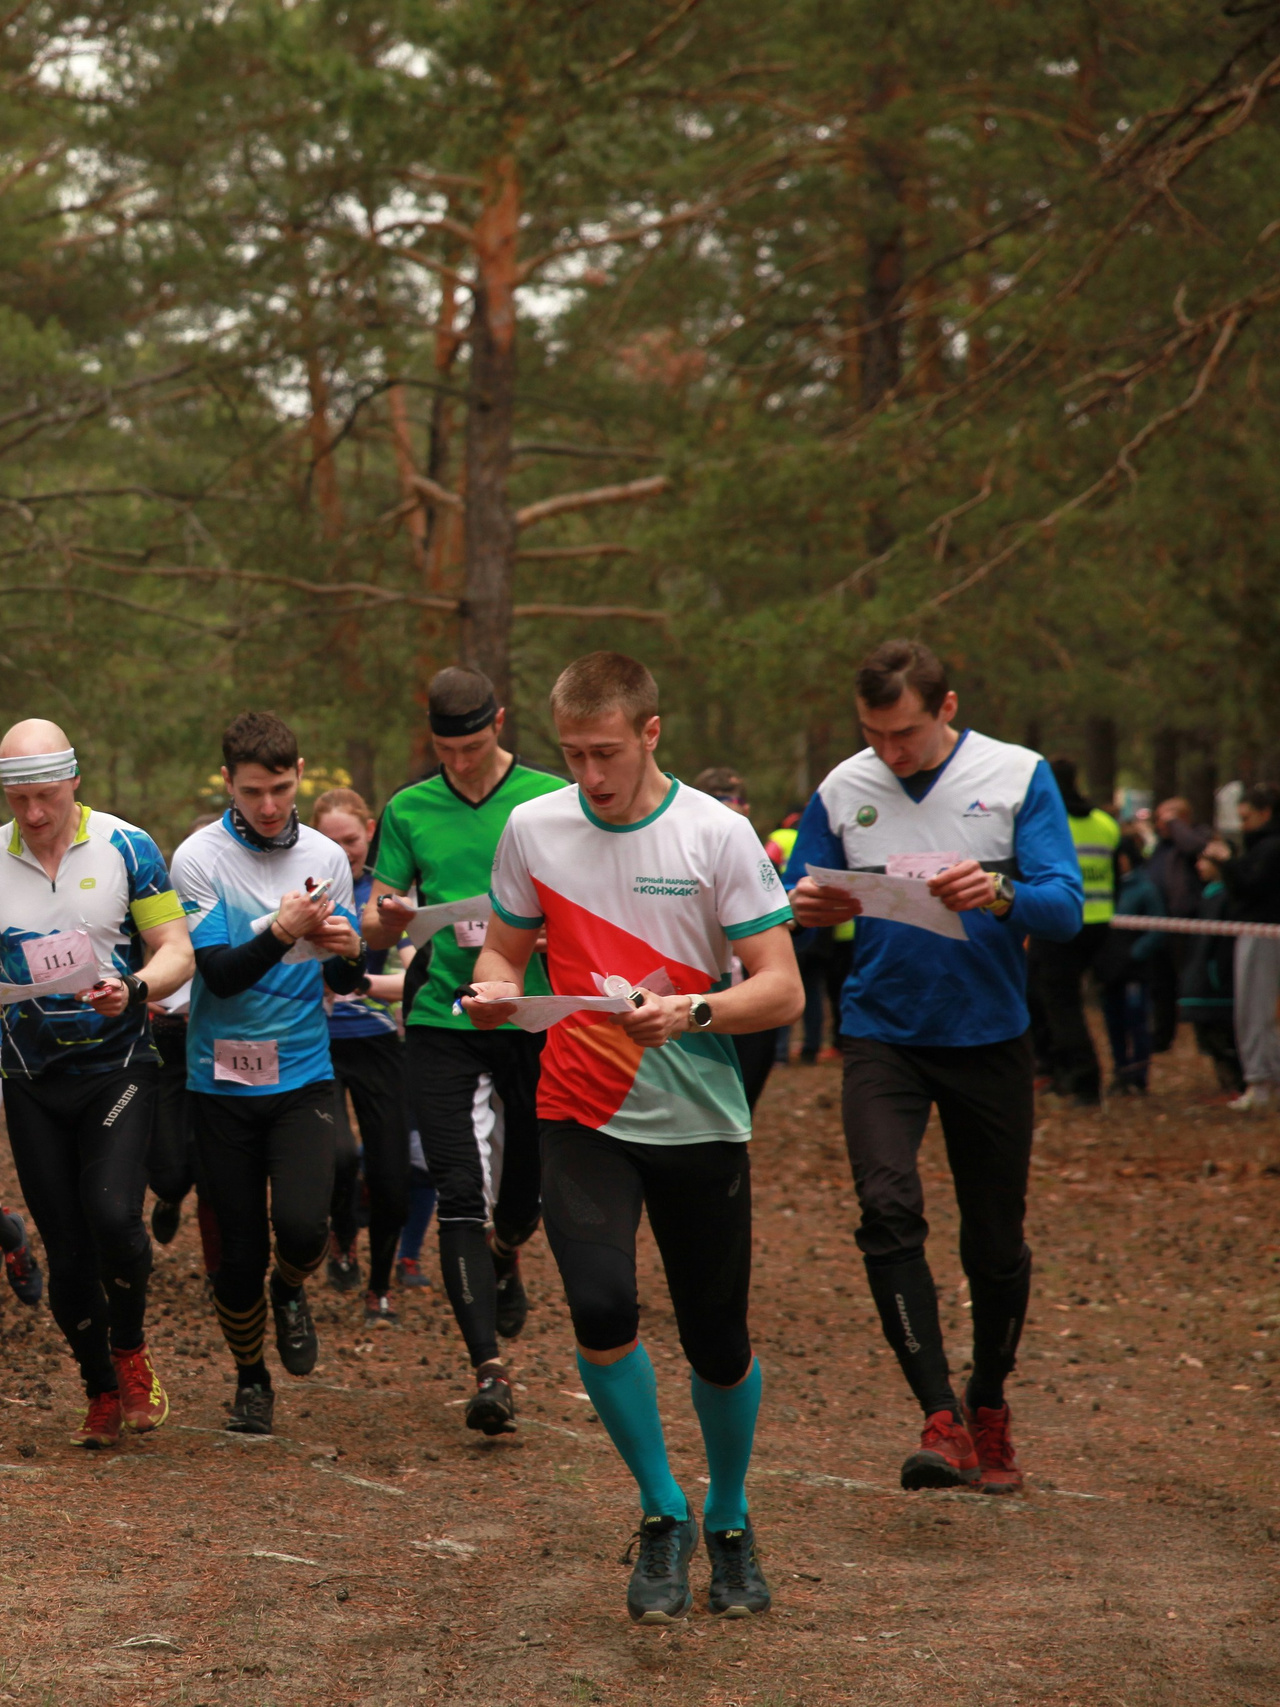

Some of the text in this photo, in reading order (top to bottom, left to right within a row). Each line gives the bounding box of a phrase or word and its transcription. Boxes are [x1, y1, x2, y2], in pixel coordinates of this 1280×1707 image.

[635, 876, 664, 884] ГОРНЫЙ
[633, 885, 699, 897] «КОНЖАК»
[43, 950, 76, 970] 11.1
[231, 1055, 262, 1071] 13.1
[103, 1083, 138, 1127] noname
